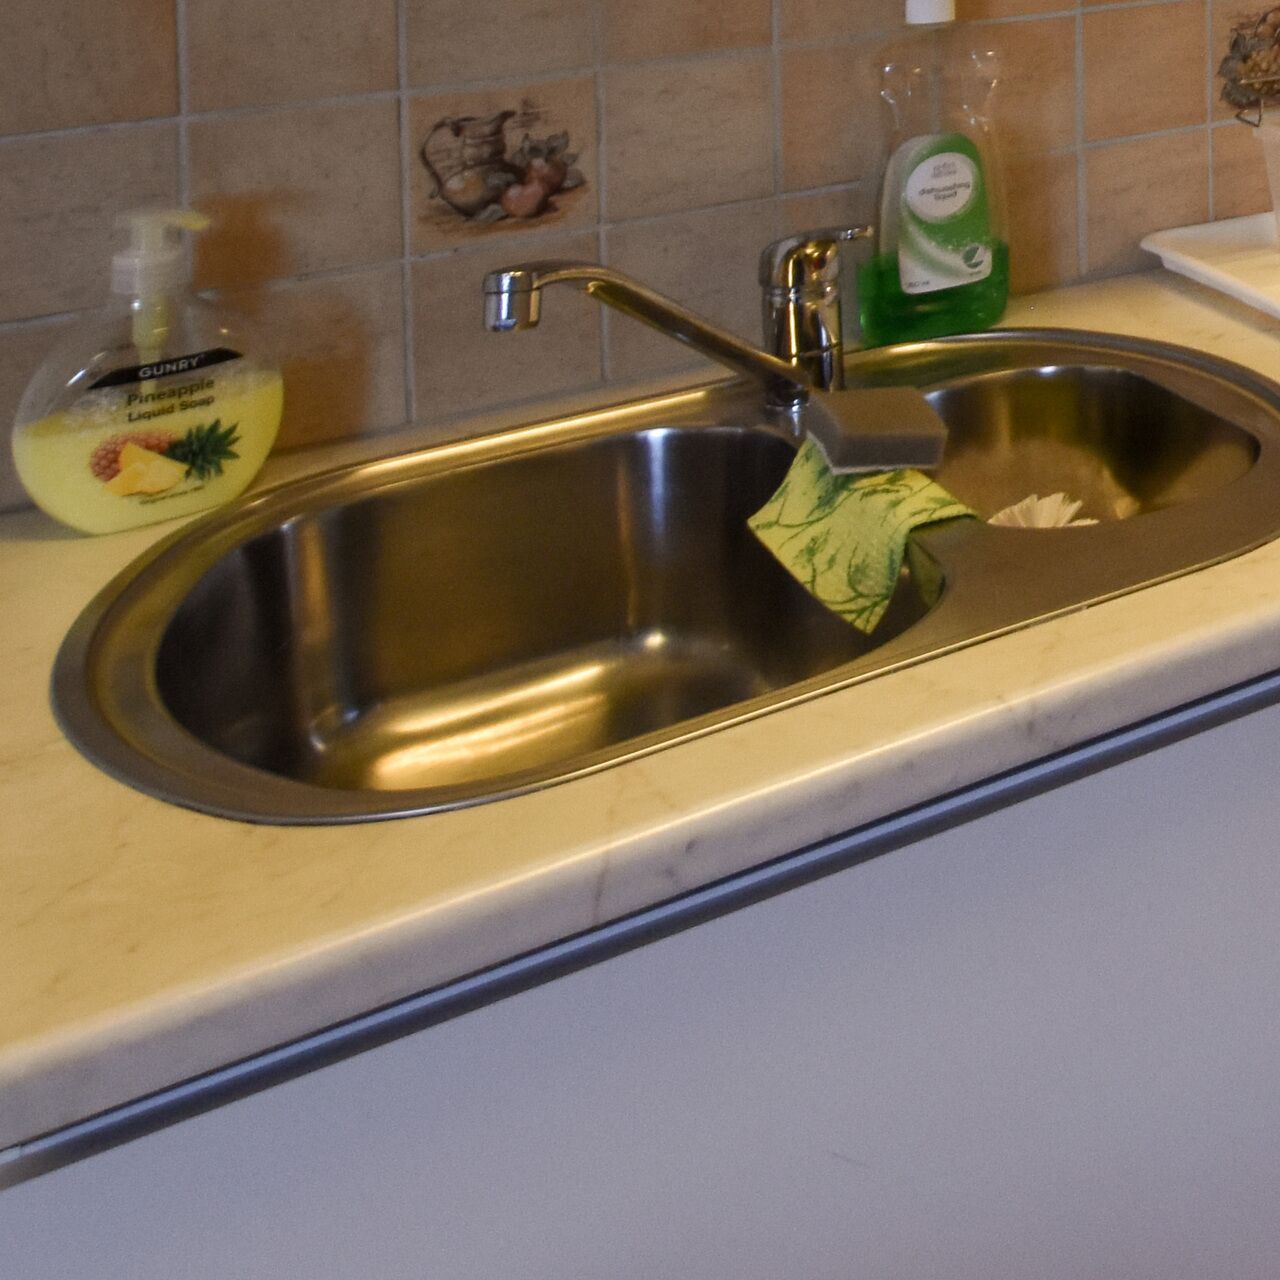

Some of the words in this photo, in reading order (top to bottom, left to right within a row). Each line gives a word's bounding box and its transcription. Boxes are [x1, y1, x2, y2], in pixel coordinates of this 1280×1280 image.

[138, 356, 200, 378] GUNRY
[126, 378, 215, 406] Pineapple
[128, 403, 175, 423] Liquid
[180, 394, 215, 412] Soap
